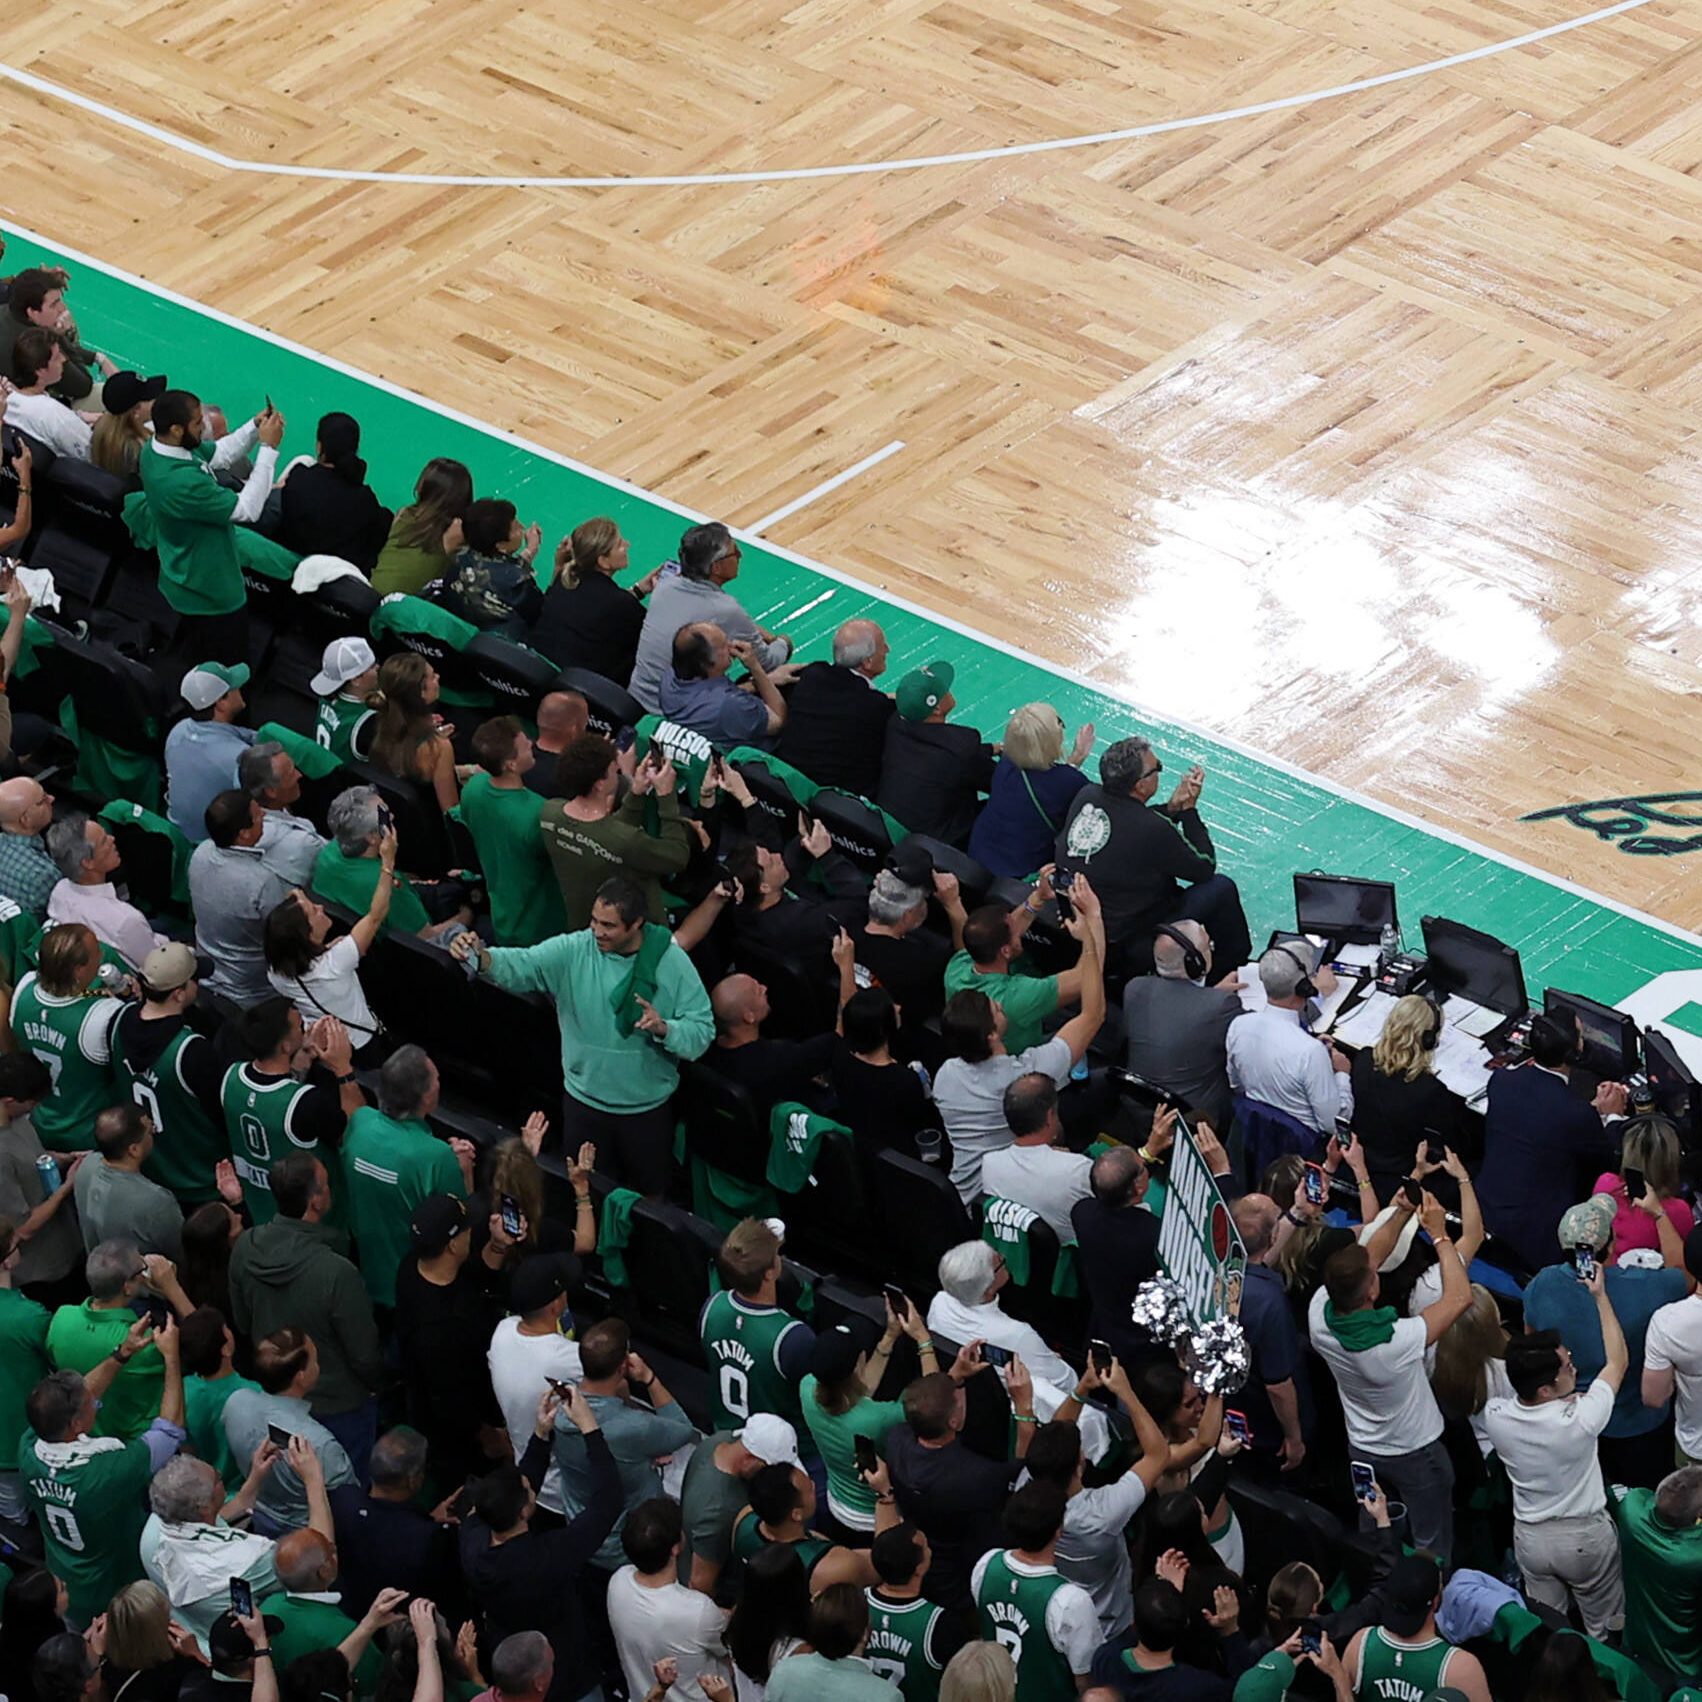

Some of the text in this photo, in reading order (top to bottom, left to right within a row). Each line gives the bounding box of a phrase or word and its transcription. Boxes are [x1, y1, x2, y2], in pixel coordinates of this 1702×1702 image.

[655, 720, 714, 763] BOSTON
[25, 1022, 67, 1051] BROWN
[32, 1047, 63, 1098] 7
[240, 1112, 271, 1161] 0
[1169, 1125, 1212, 1243] MAKE
[711, 1339, 755, 1373] TATUM
[720, 1364, 749, 1419] 0
[30, 1479, 77, 1508] TATUM
[46, 1503, 85, 1552] 0
[986, 1602, 1030, 1638] BROWN
[1374, 1677, 1424, 1702] TATUM
